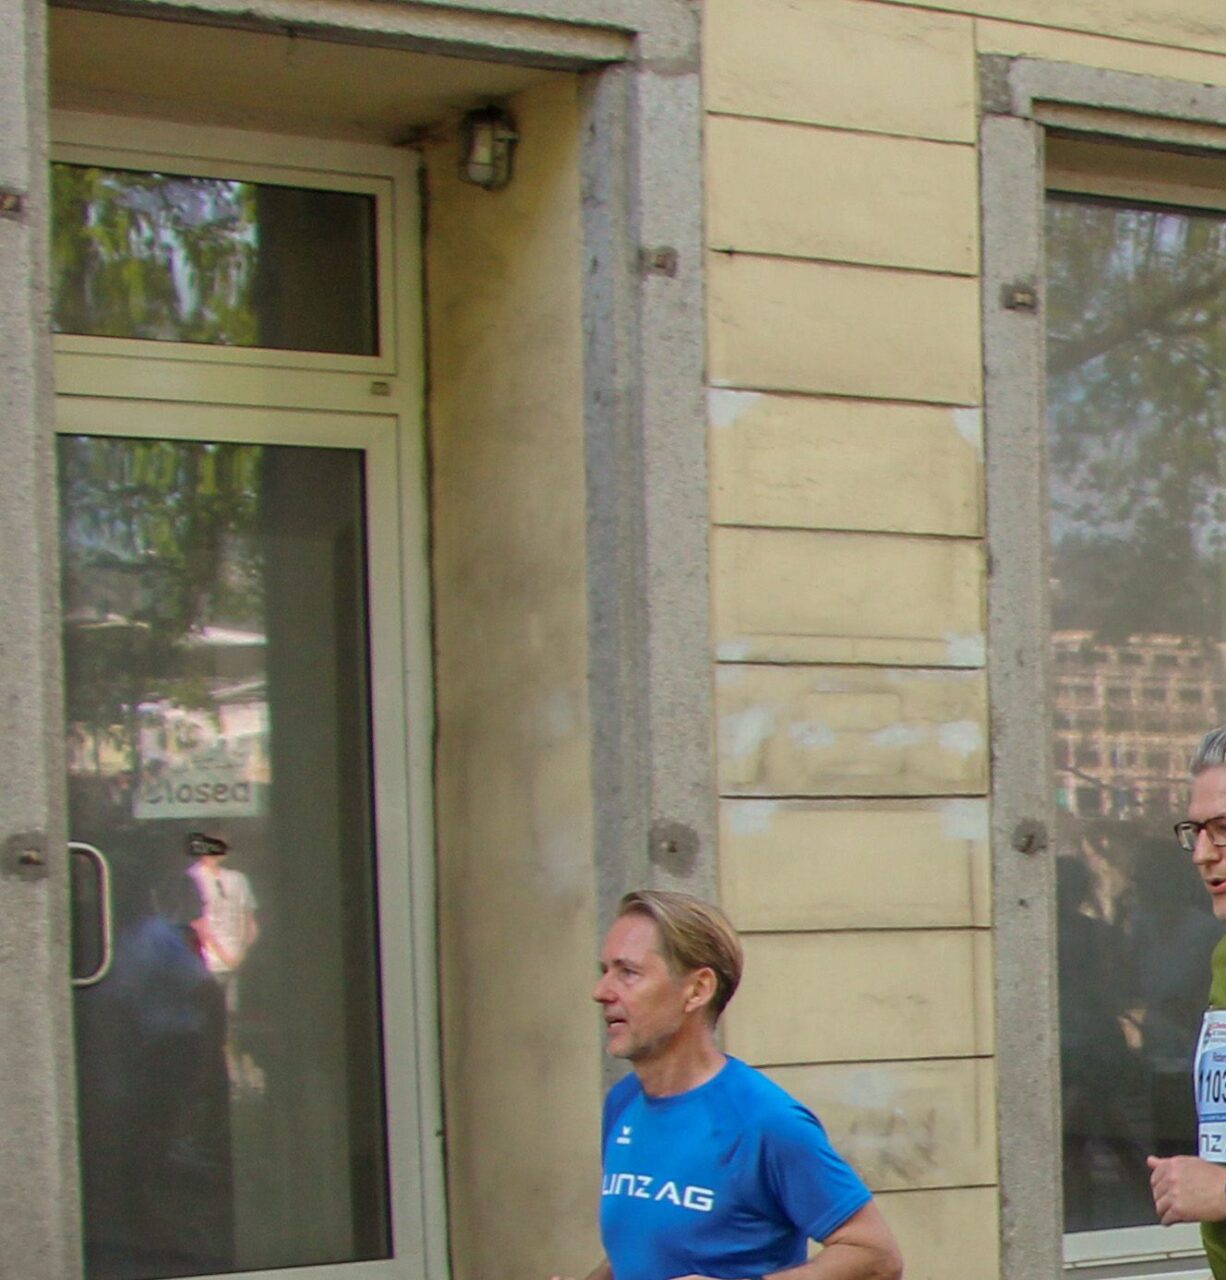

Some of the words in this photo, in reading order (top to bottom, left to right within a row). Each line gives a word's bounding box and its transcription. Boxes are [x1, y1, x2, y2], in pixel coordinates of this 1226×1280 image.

[1200, 1134, 1222, 1153] NZ
[602, 1173, 653, 1198] LINZ
[655, 1181, 715, 1211] AG
